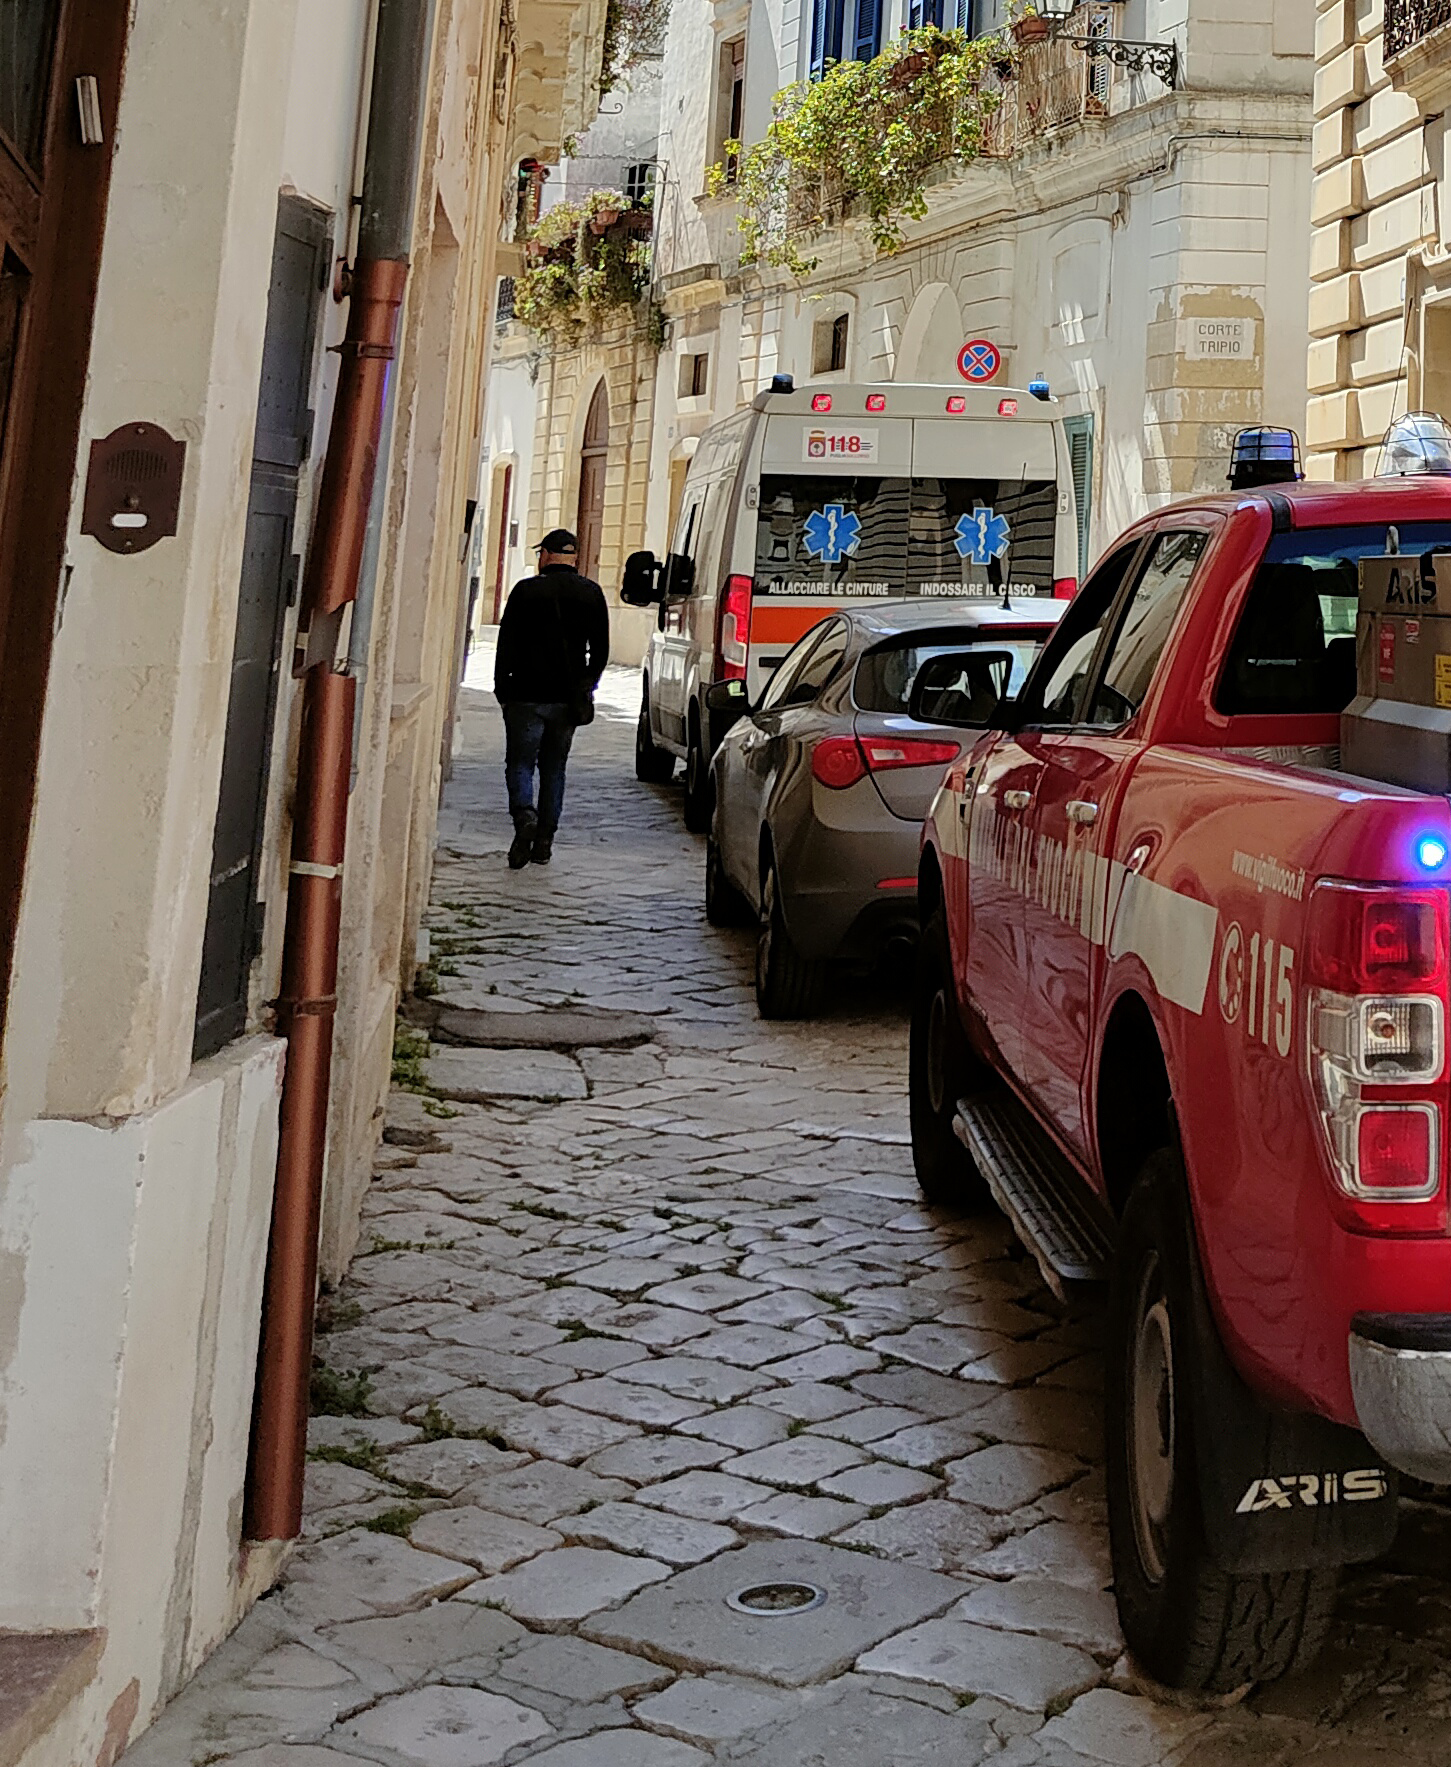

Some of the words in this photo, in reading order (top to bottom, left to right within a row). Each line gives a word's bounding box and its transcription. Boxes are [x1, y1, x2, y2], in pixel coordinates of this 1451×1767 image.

[1198, 324, 1241, 335] CORTE
[1199, 340, 1241, 353] TRIPIO
[827, 435, 861, 453] 118
[768, 581, 830, 595] ALLACCIARE
[831, 582, 844, 595] LE
[845, 582, 889, 596] CINTURE
[920, 582, 983, 596] INDOSSARE
[985, 583, 996, 596] IL
[998, 583, 1036, 596] CASCO
[1034, 833, 1081, 927] FUOCO
[1232, 850, 1306, 901] www.vigilfuoco.it
[1248, 931, 1294, 1057] 115
